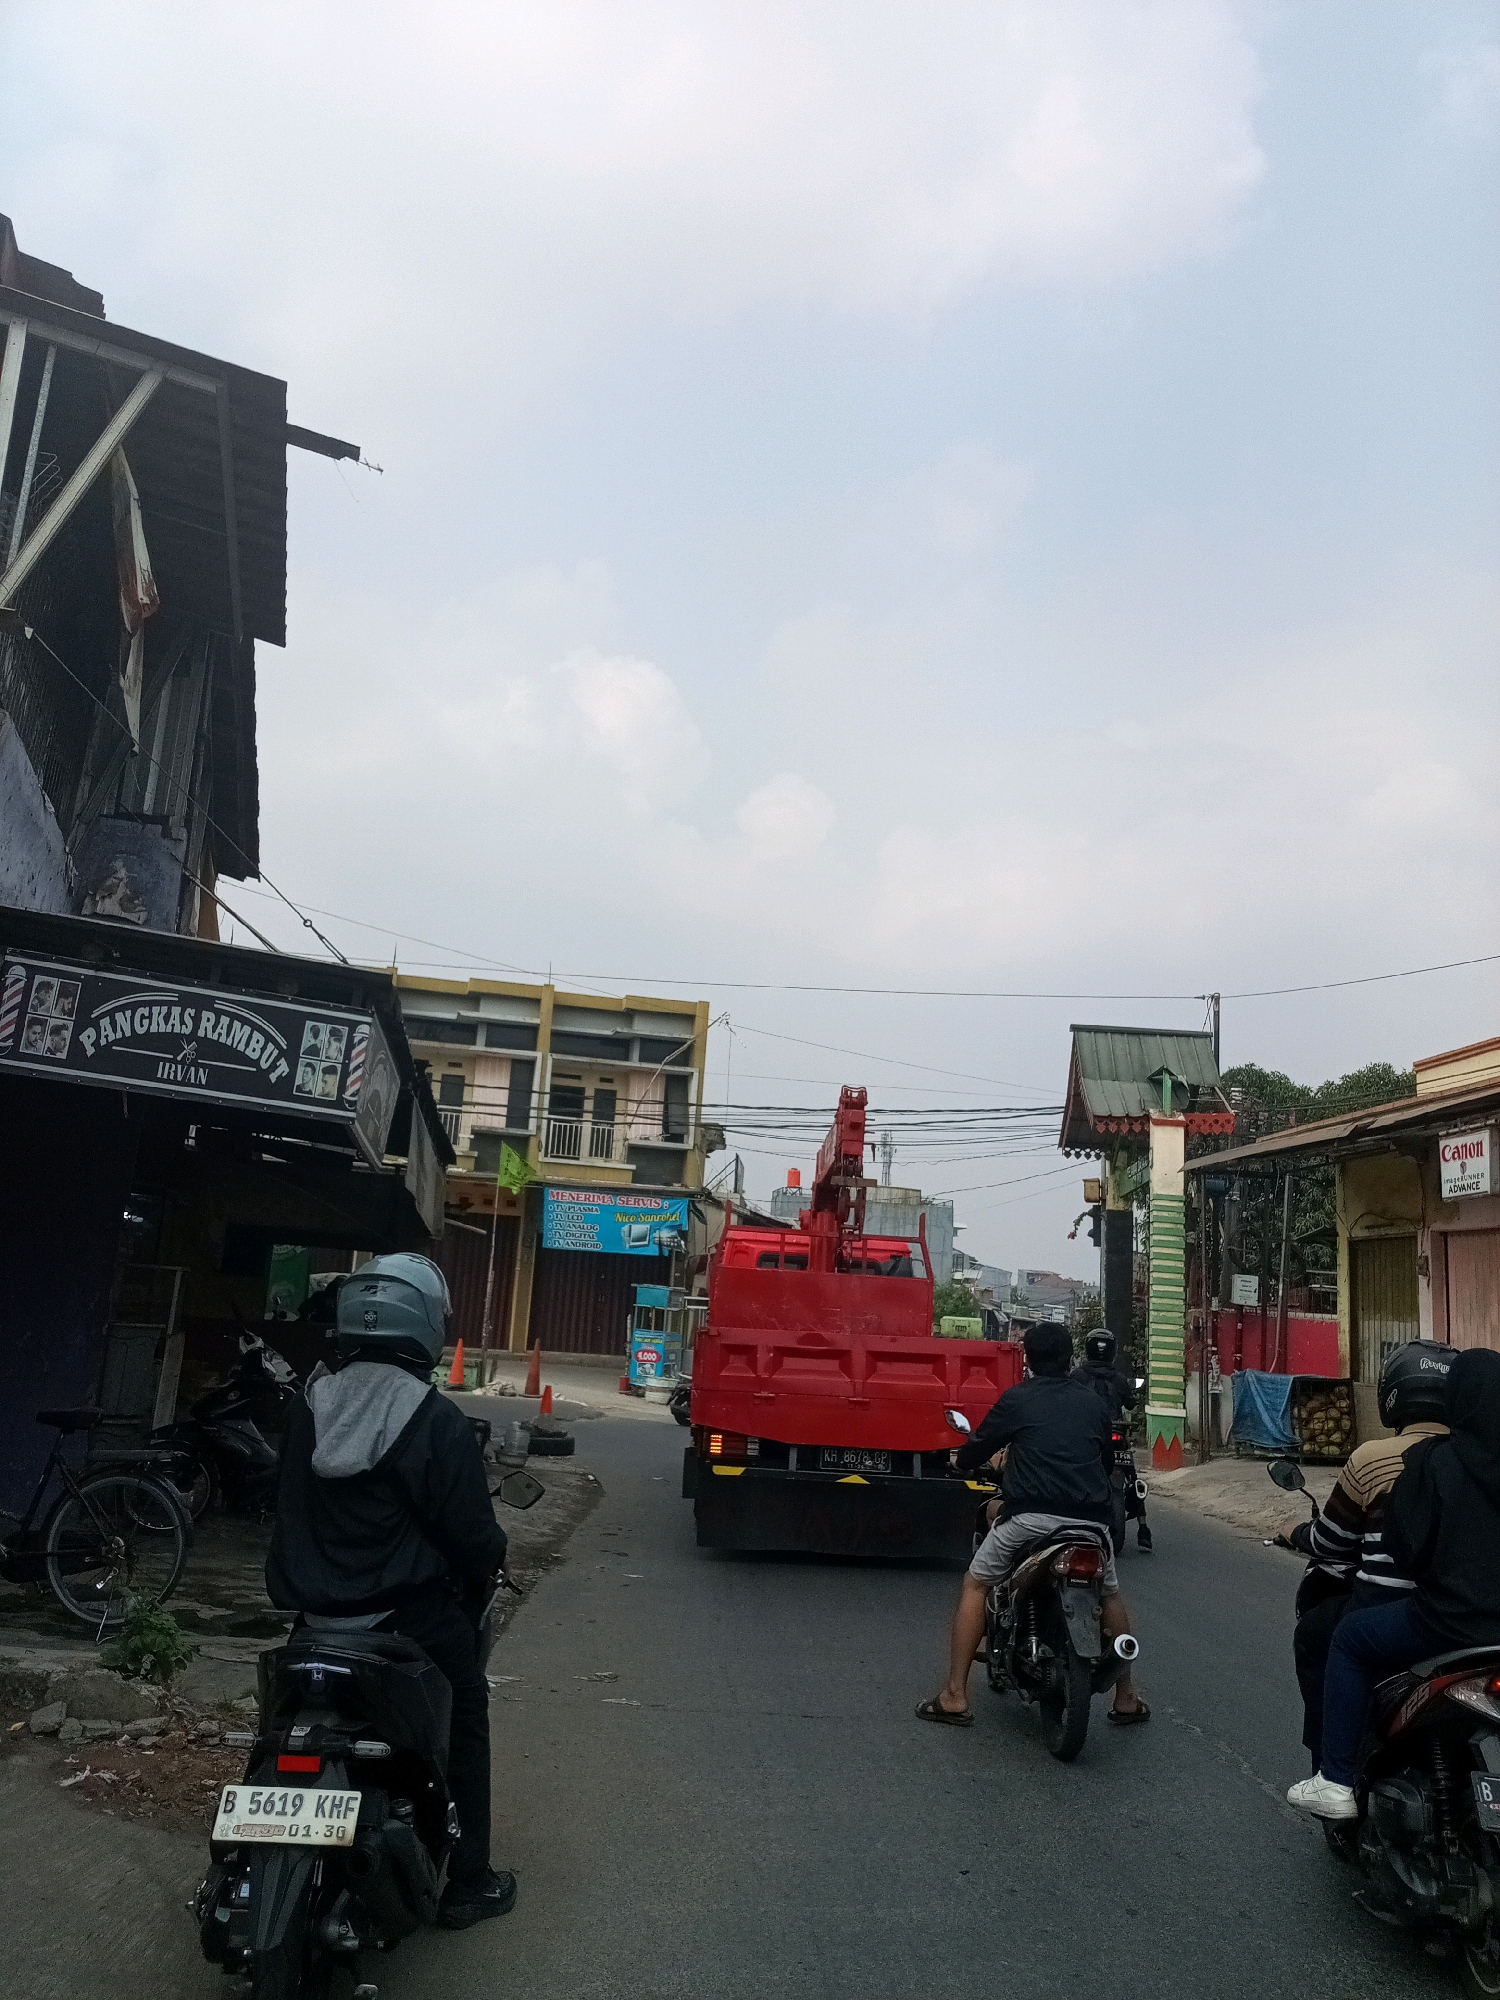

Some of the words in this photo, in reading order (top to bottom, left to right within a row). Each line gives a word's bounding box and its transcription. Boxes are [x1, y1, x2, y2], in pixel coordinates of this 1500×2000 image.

[78, 1006, 195, 1058] PANGKAS
[197, 1010, 290, 1084] RAMBUT
[156, 1061, 209, 1085] IRVAN
[1441, 1139, 1484, 1163] Canon
[1448, 1181, 1480, 1194] ADVANCE
[549, 1190, 614, 1205] MENERIMA
[617, 1197, 662, 1209] SERVIS
[567, 1205, 600, 1214] PLASMA
[615, 1212, 636, 1222] Nico
[554, 1213, 566, 1221] TV
[567, 1213, 584, 1222] LCD
[553, 1222, 565, 1230] TV
[566, 1224, 599, 1232] ANALOG
[553, 1231, 564, 1240] TV
[565, 1232, 597, 1240] DIGITAL
[553, 1240, 564, 1249] TV
[564, 1241, 602, 1250] ANDROID
[824, 1449, 837, 1462] KH
[843, 1450, 869, 1463] 8678
[874, 1451, 887, 1464] GP
[1401, 1681, 1430, 1726] 125
[1481, 1782, 1493, 1802] B
[223, 1790, 238, 1814] B
[248, 1791, 304, 1817] 5619
[315, 1794, 359, 1819] KHF
